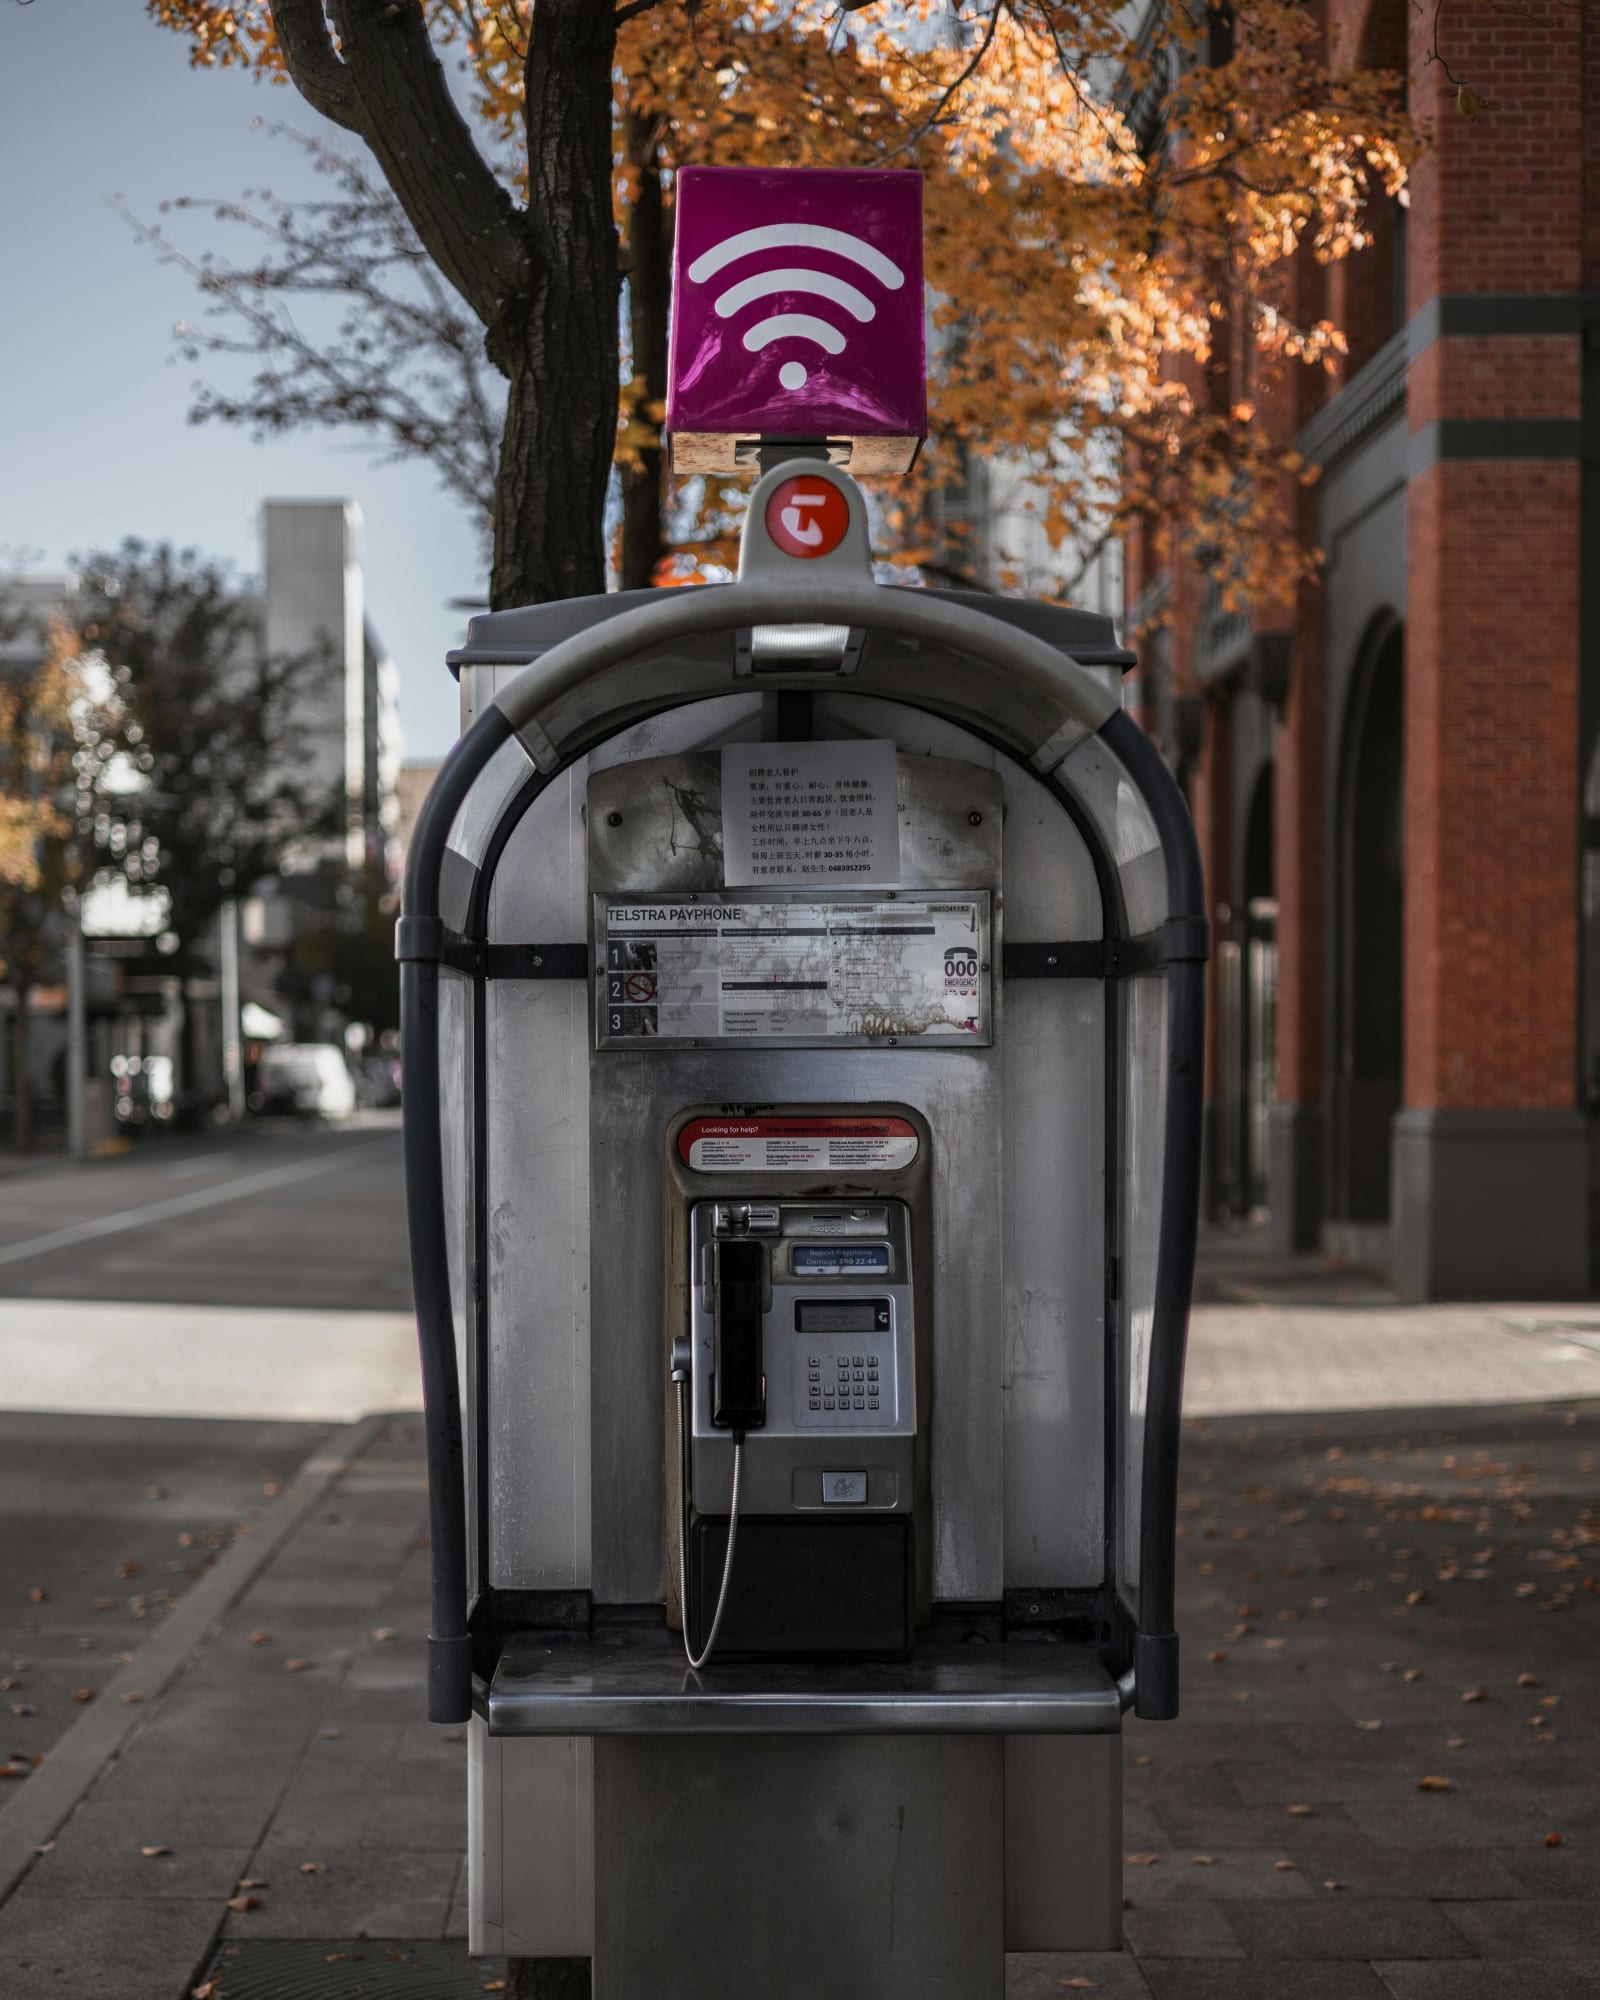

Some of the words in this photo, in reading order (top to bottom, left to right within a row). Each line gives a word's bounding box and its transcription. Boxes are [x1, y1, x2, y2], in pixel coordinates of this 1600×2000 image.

[801, 809, 822, 818] 30-65
[823, 850, 844, 859] 30-35
[608, 909, 666, 921] TELSTRA
[669, 908, 741, 921] PAYPHONE
[611, 948, 619, 964] 1
[944, 960, 978, 977] 000
[944, 977, 978, 987] EMERGENCY
[611, 981, 621, 997] 2
[611, 1014, 621, 1030] 3
[701, 1126, 729, 1135] Looking
[729, 1126, 740, 1134] for
[740, 1126, 760, 1134] help?
[809, 1249, 835, 1257] Report
